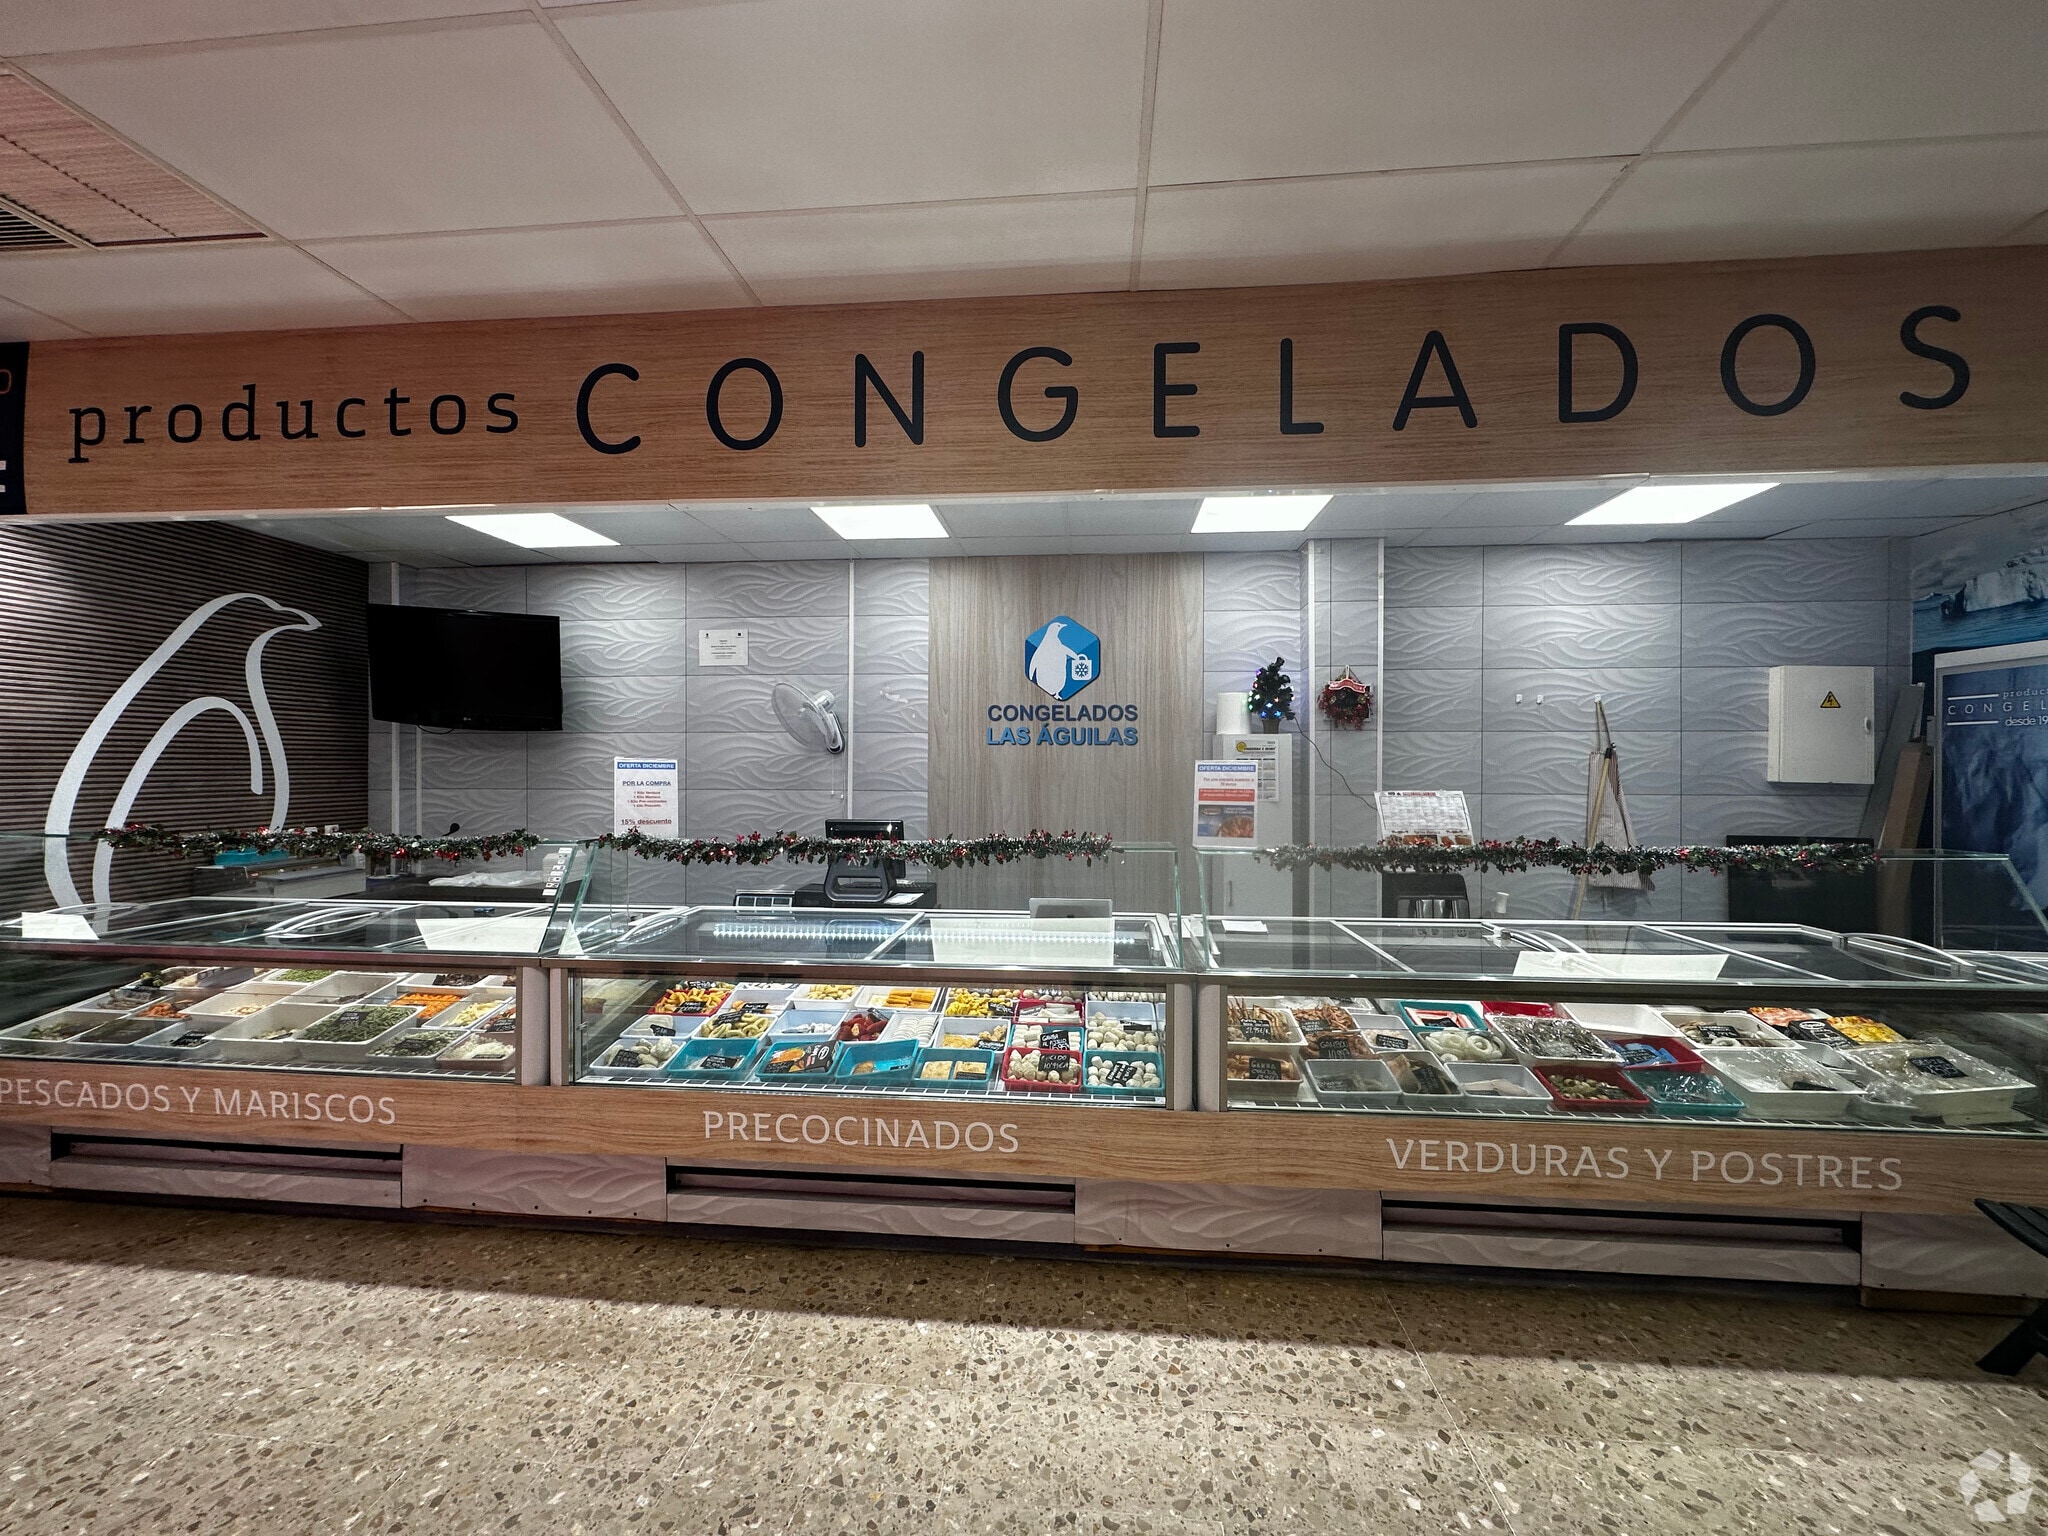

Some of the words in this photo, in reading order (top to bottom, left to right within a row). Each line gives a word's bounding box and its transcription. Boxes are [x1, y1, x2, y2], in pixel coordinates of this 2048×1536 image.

[68, 383, 519, 464] productos
[576, 305, 1970, 454] CONGELADOS
[987, 704, 1139, 722] CONGELADOS
[2004, 716, 2037, 726] desde
[986, 727, 1031, 745] LAS
[1036, 723, 1139, 746] ÁGUILAS
[620, 818, 636, 826] 15%
[0, 1077, 171, 1112] PESCADOS
[180, 1086, 202, 1113] Y
[212, 1087, 397, 1125] MARISCOS
[702, 1110, 1020, 1153] PRECOCINADOS
[1385, 1138, 1630, 1179] VERDURAS
[1643, 1148, 1673, 1181] Y
[1690, 1150, 1903, 1191] POSTRES
